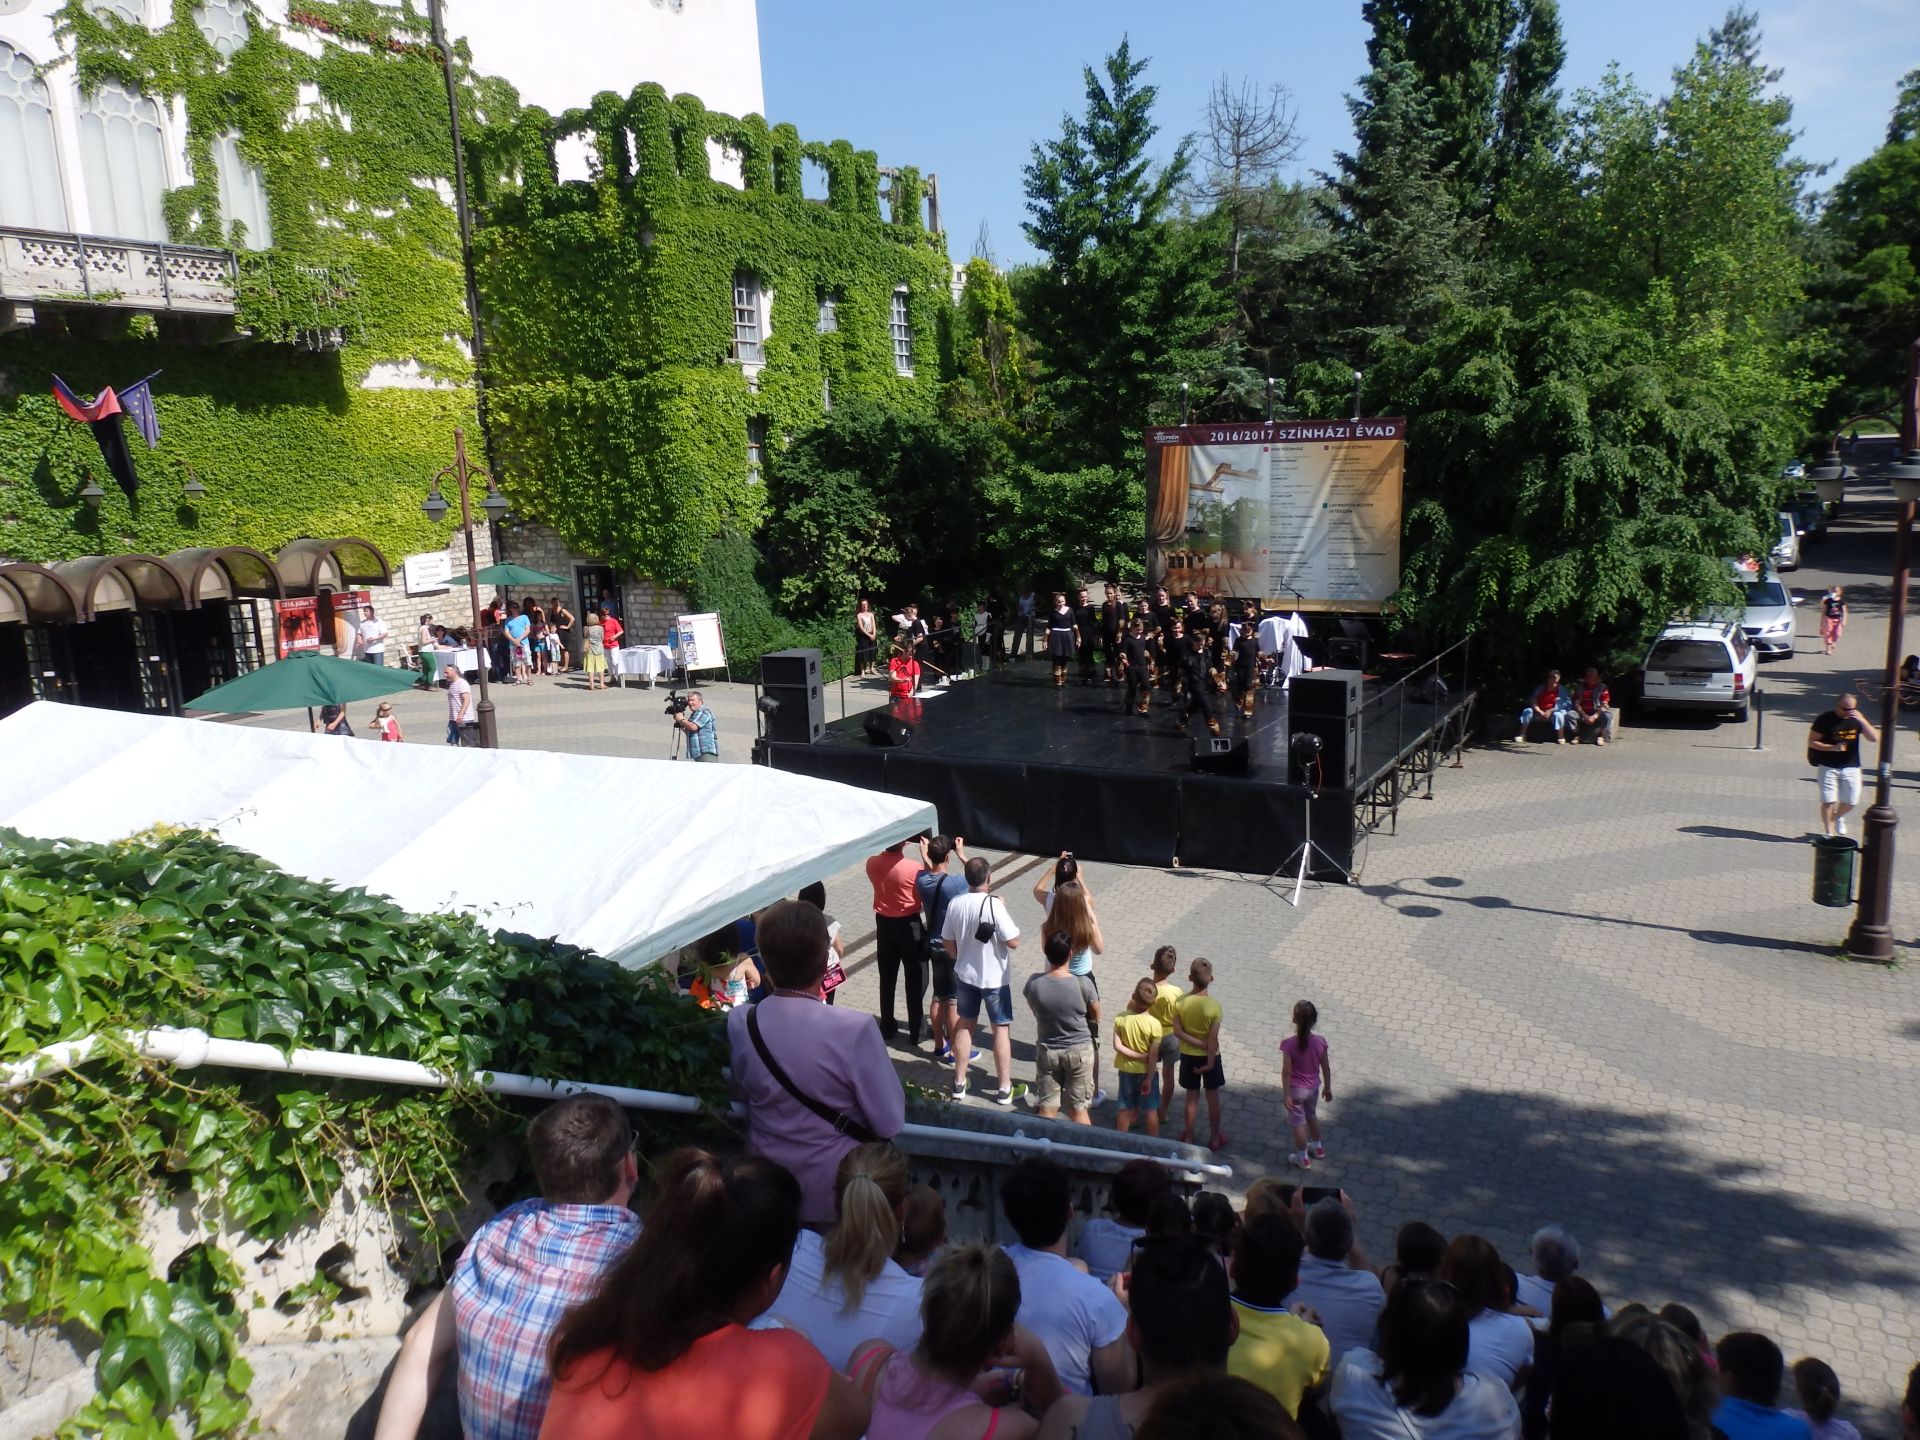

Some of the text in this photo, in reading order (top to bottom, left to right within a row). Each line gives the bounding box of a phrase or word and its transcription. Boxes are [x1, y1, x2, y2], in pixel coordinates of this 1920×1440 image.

[1210, 424, 1396, 442] 2016/2017 SZÍNHÁZI ÉVAD
